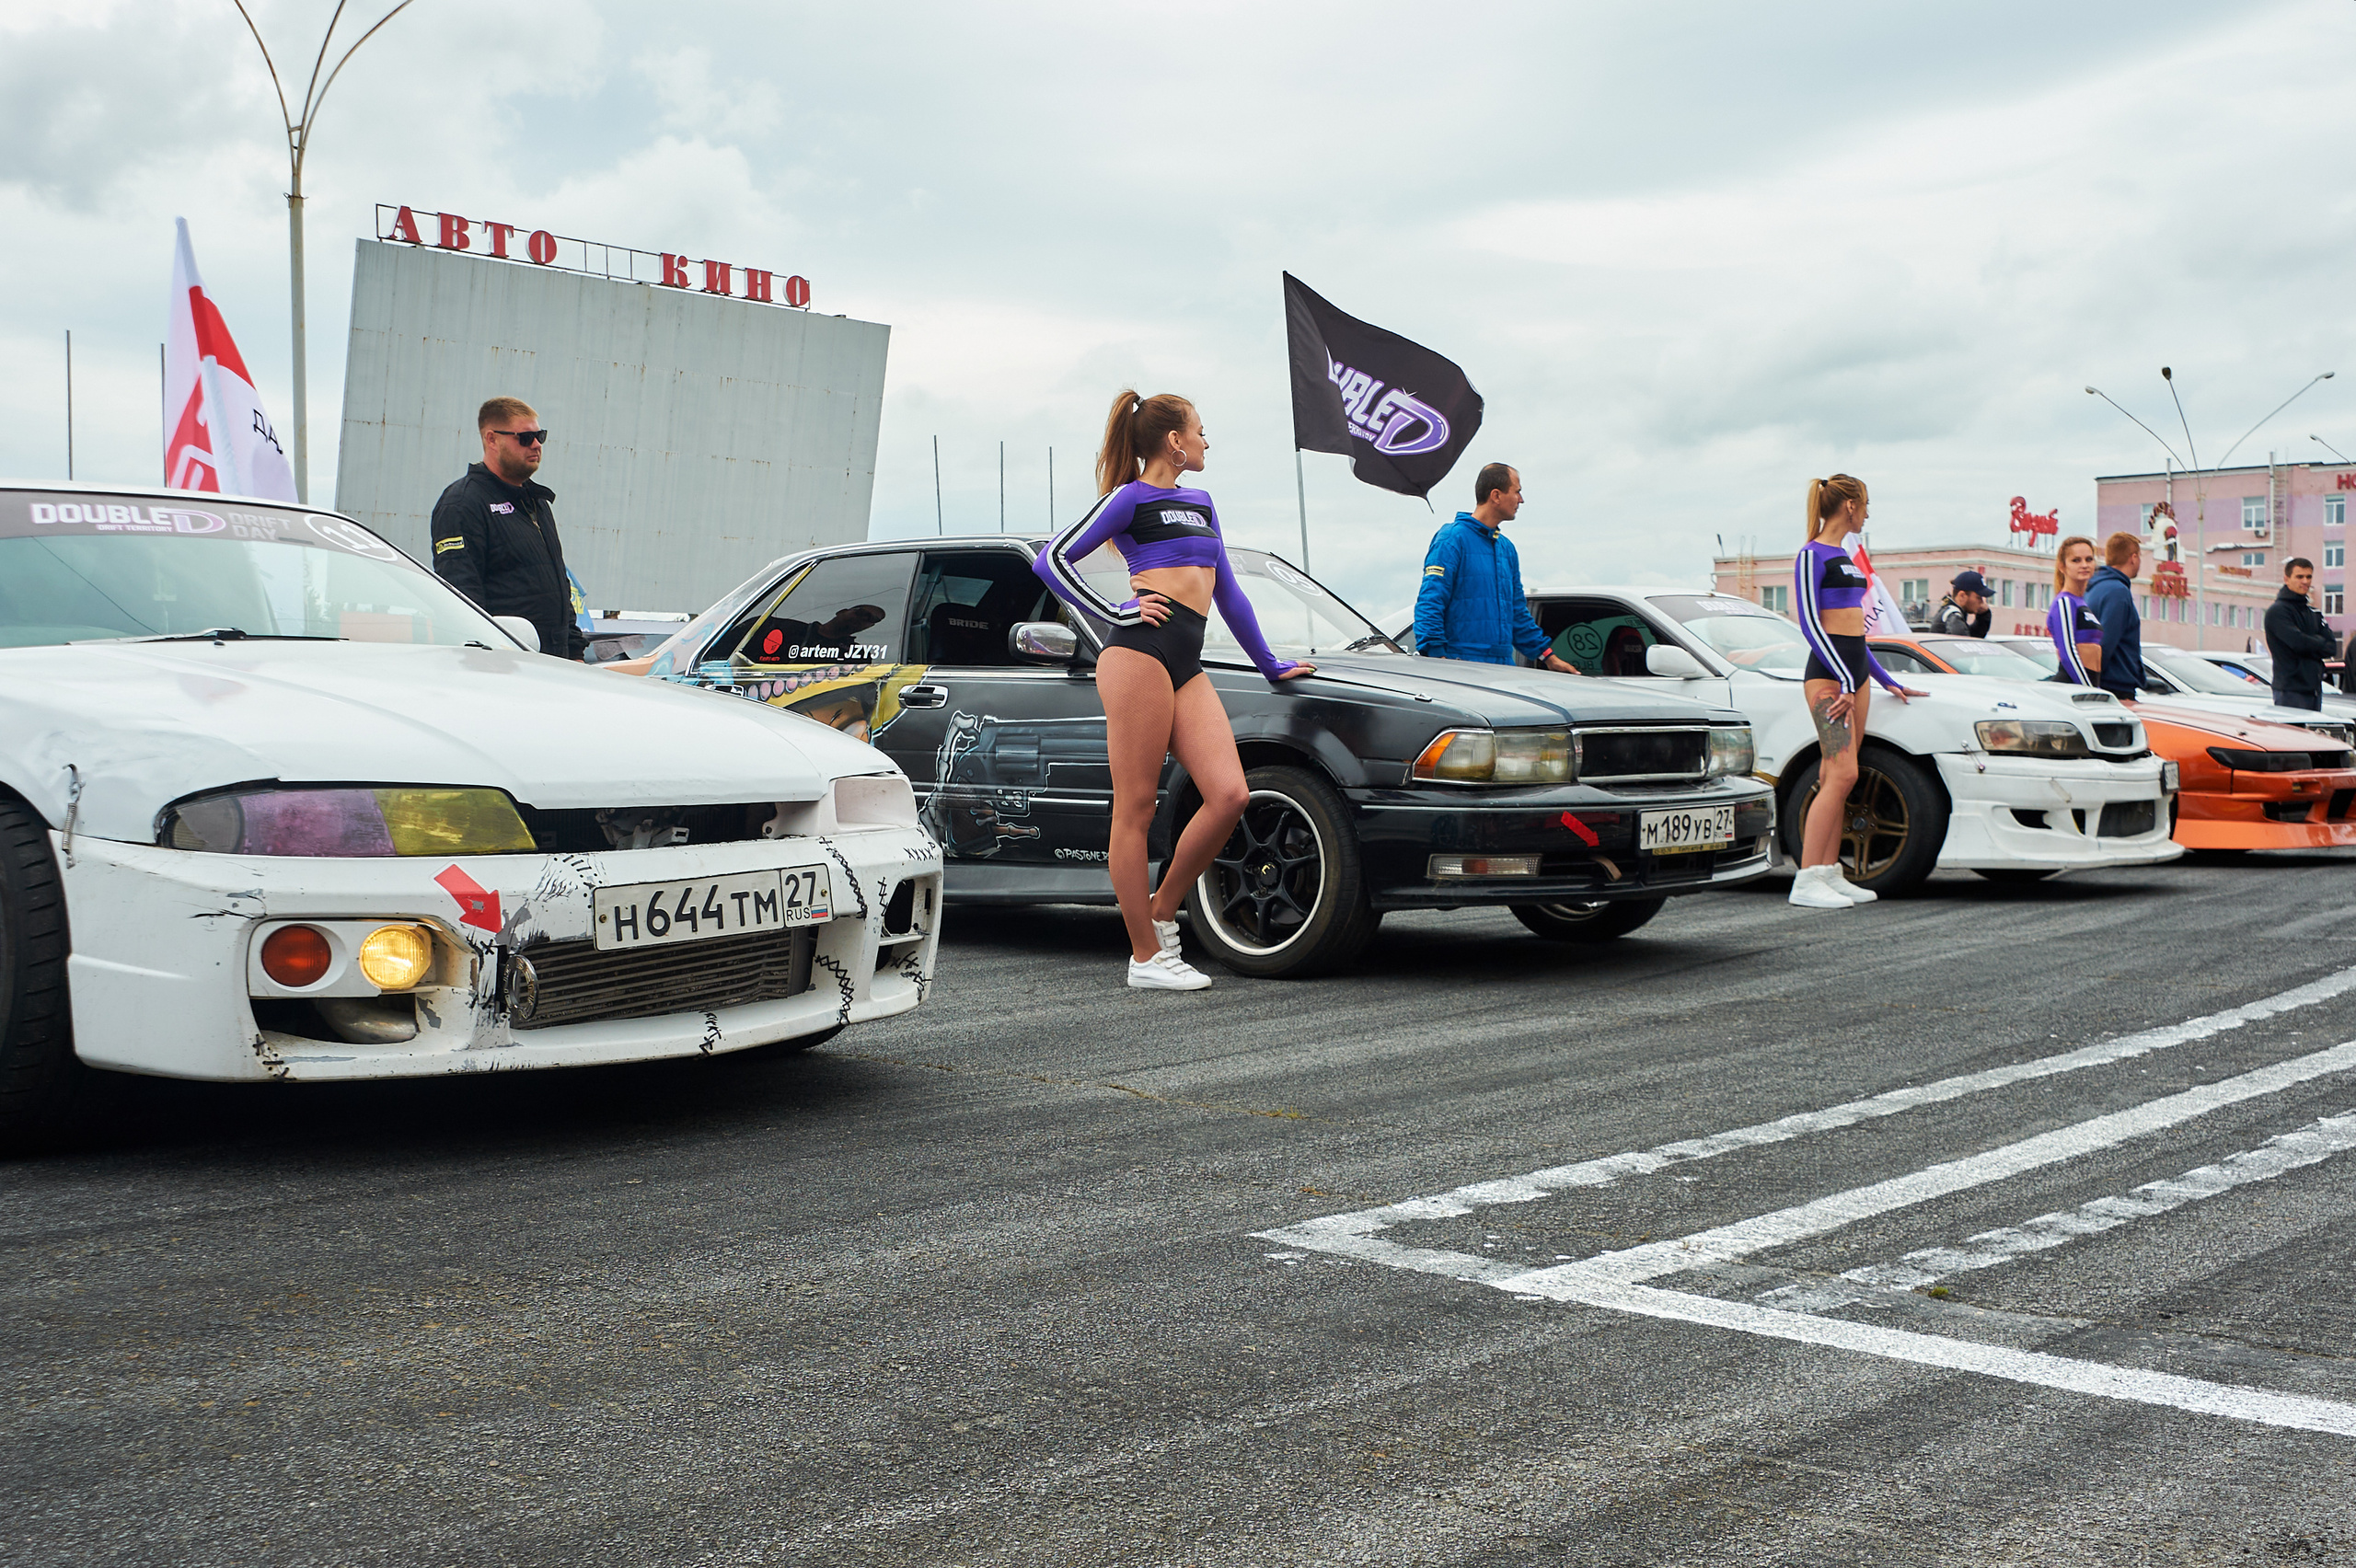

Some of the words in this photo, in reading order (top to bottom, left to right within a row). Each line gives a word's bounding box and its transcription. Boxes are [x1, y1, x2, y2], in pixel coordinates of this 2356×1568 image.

[387, 205, 558, 265] АВТО
[659, 252, 810, 307] КИНО
[125, 525, 173, 533] TERRITORY
[228, 513, 291, 531] DRIFT
[232, 525, 277, 541] DAY
[322, 524, 385, 550] 11
[1273, 566, 1316, 590] 05
[948, 617, 989, 630] BRIDE
[1646, 813, 1712, 845] М189УВ
[1715, 809, 1730, 830] 27
[614, 884, 780, 942] Н644ТМ
[785, 870, 817, 908] 27
[786, 906, 812, 921] RUS
